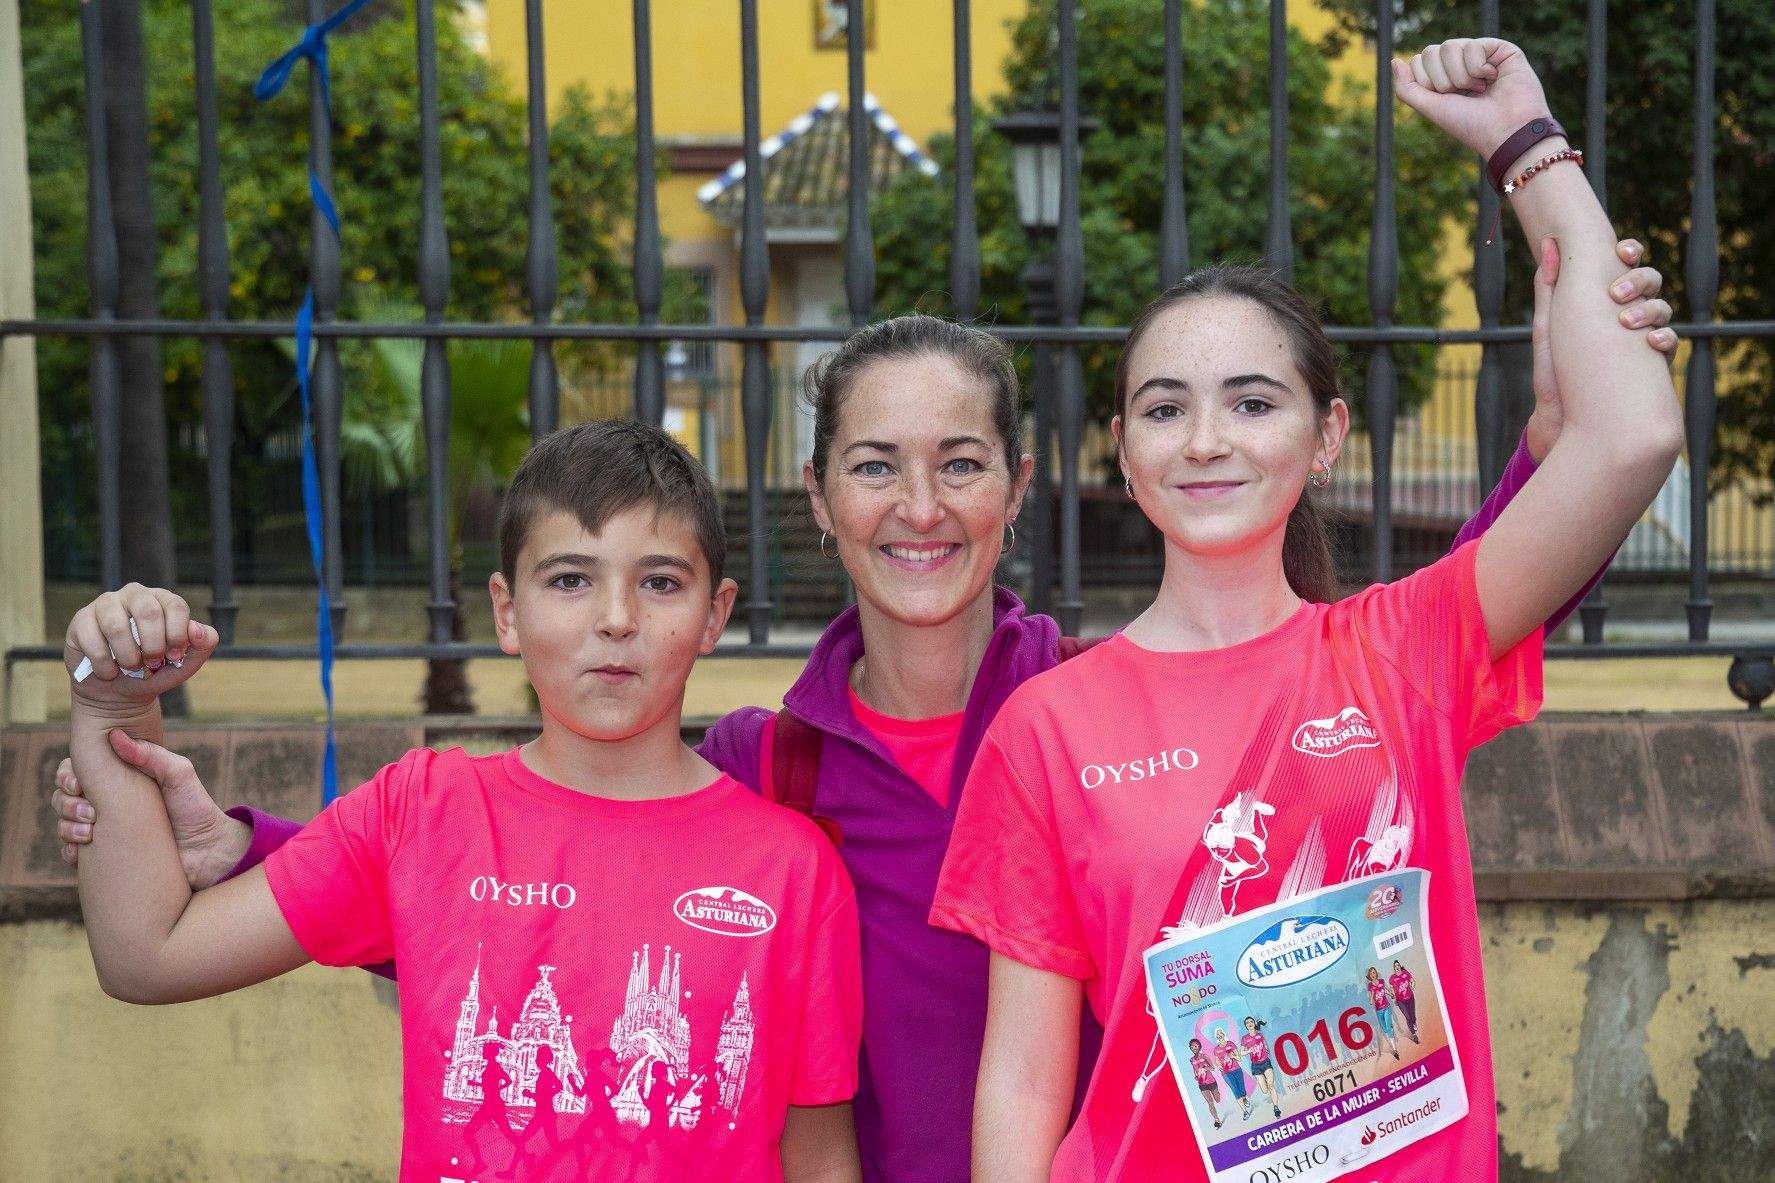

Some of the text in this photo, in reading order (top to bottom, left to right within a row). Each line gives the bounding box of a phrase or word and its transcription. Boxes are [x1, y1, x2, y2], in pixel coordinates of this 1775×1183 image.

[1081, 747, 1199, 789] OYSHO
[470, 876, 576, 909] OYSHO
[681, 899, 768, 929] ASTURIANA
[1248, 932, 1346, 982] ASTURIANA
[1260, 924, 1338, 958] CENTRAL LECHERA
[1161, 950, 1212, 974] TU DORSAL
[1165, 961, 1216, 989] SUMA
[1273, 1006, 1374, 1077] 016
[1313, 1069, 1358, 1102] 6071
[1247, 1064, 1430, 1152] CARRERA DE LA MUJER SEVILLA
[1377, 1098, 1441, 1138] Santander
[1250, 1144, 1330, 1183] OYSHO
